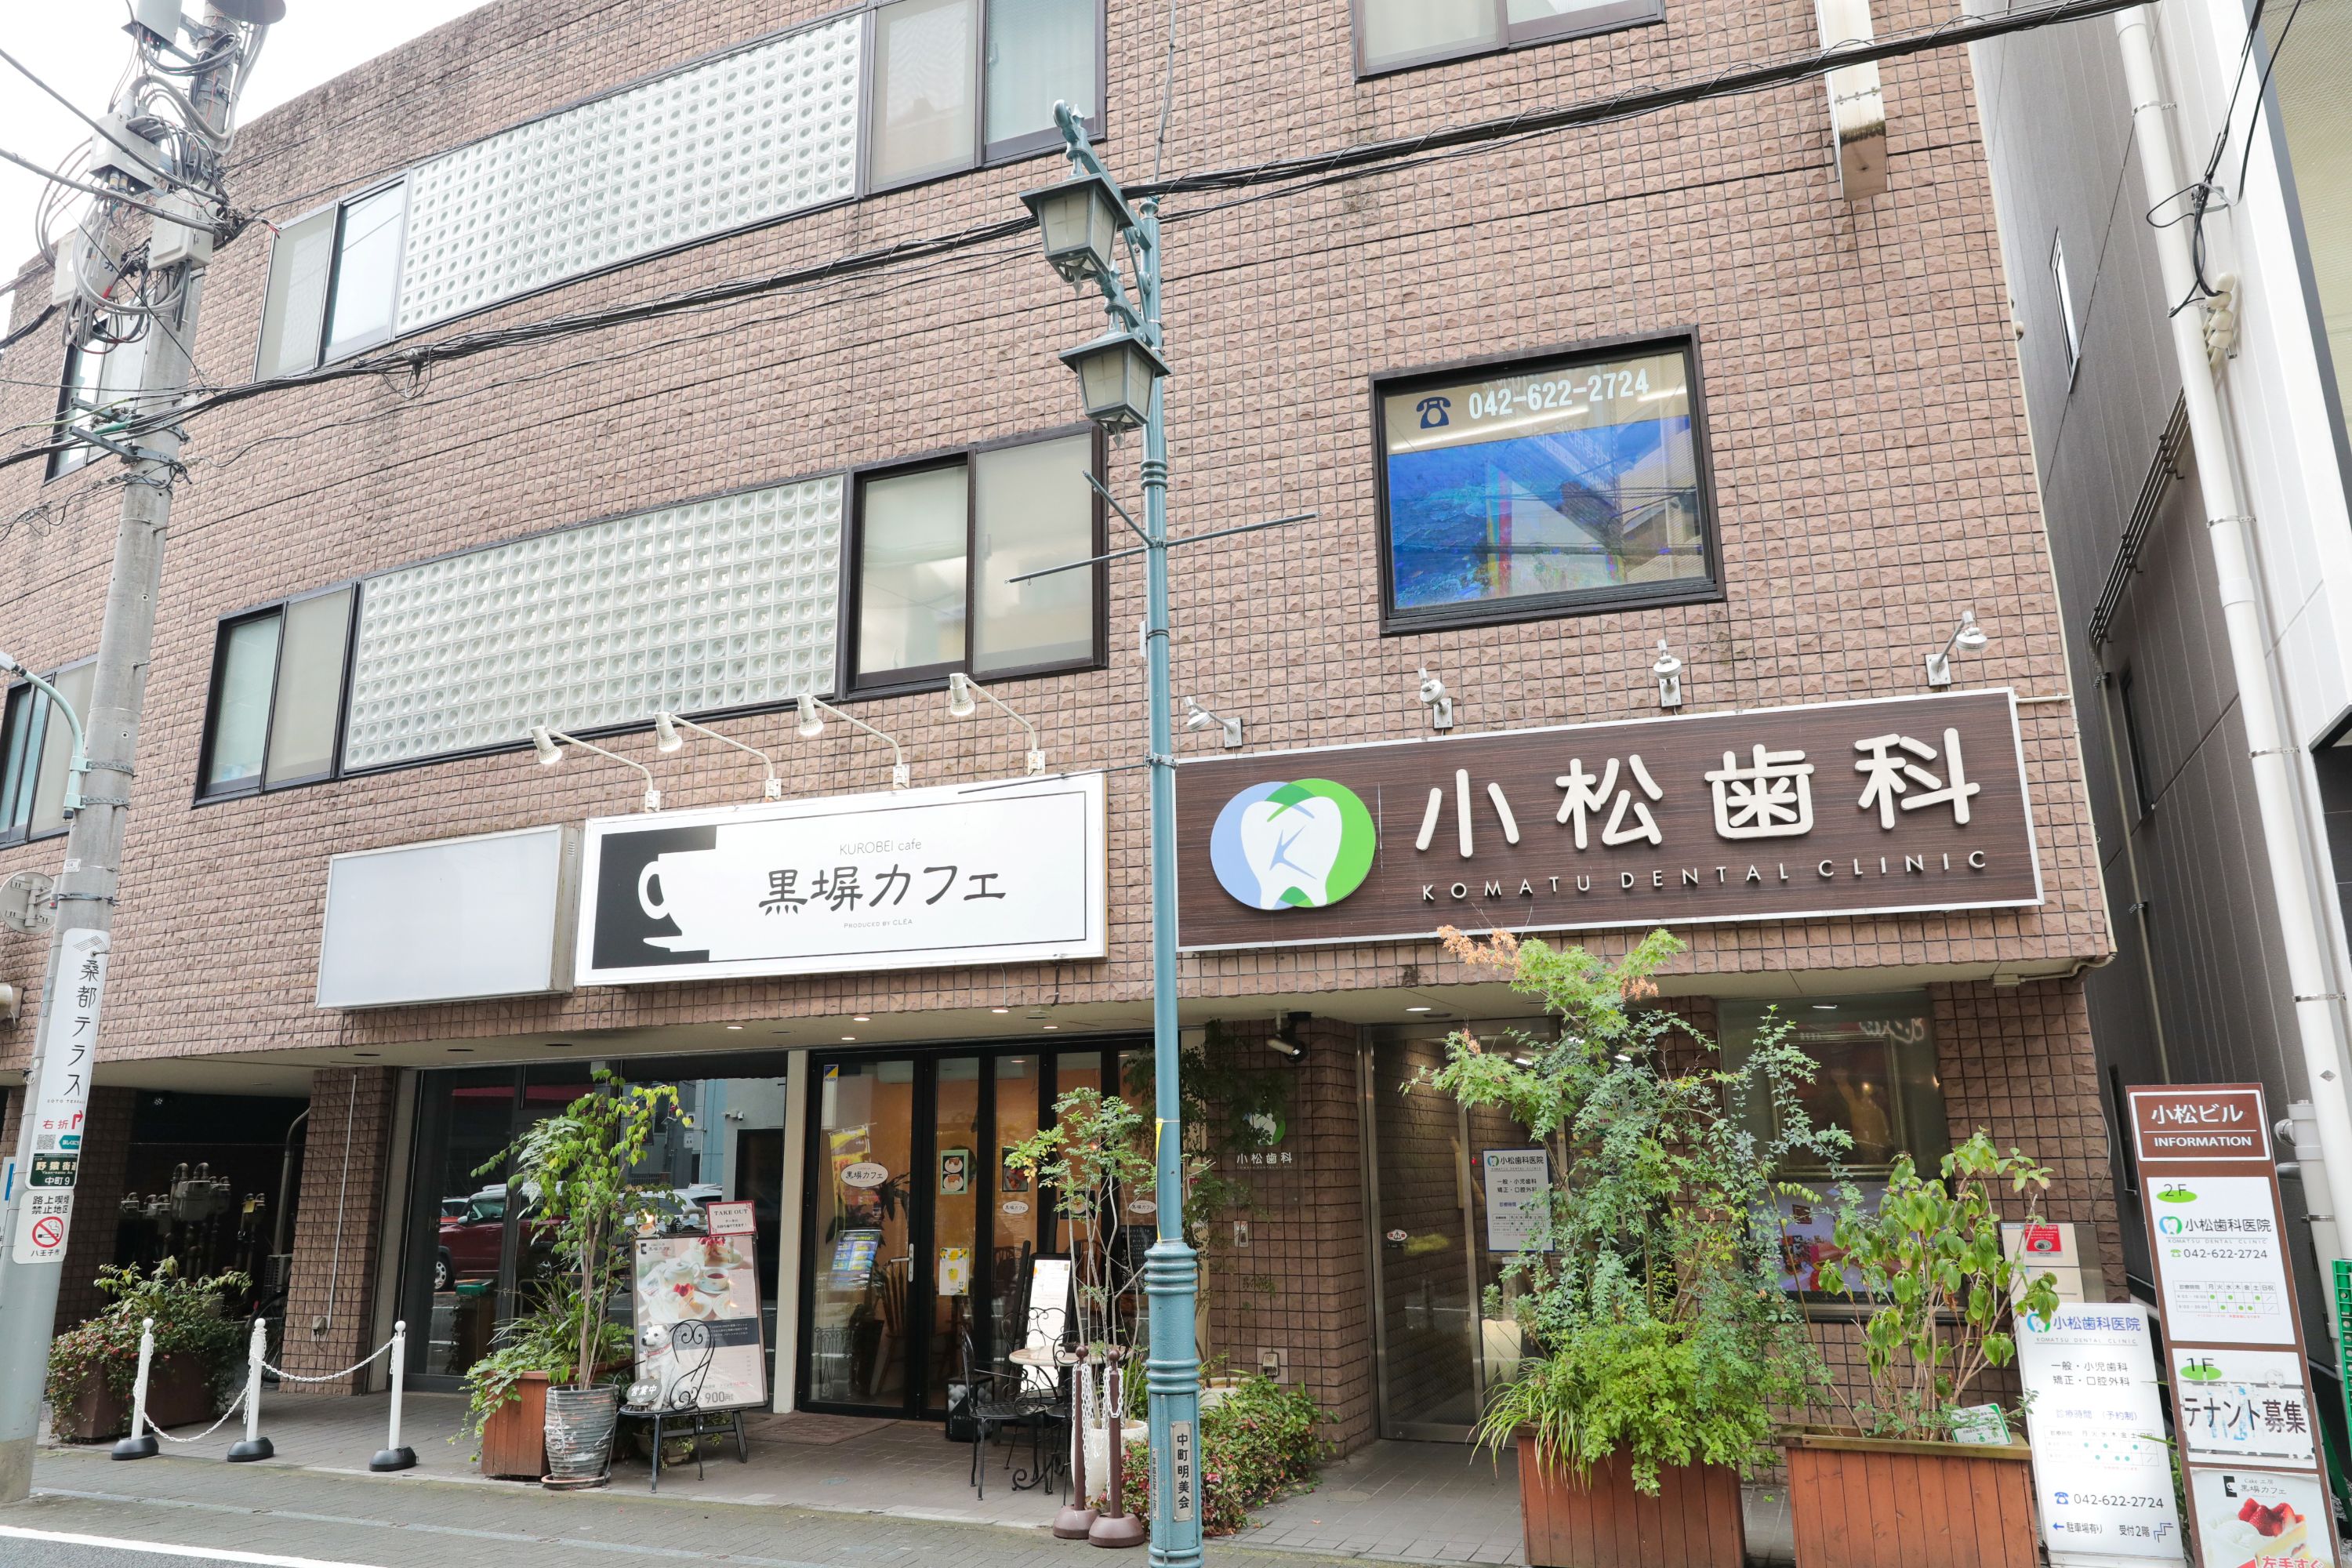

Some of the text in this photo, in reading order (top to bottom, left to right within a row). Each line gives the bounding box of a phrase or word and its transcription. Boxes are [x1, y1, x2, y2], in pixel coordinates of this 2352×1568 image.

[1468, 368, 1650, 419] 042-622-2724
[1415, 726, 1981, 859] 小松歯科
[840, 838, 922, 855] KUROBEI cafe
[1422, 851, 1987, 901] KOMATU DENTAL CLINIC
[758, 863, 1007, 916] 黒塀カフェ
[64, 960, 100, 1096] 桑都テラス
[2151, 1103, 2244, 1124] 小松ビル
[43, 1120, 68, 1130] 右折
[2154, 1136, 2252, 1146] INFORMATION
[1236, 1152, 1292, 1164] 小松歯科
[1500, 1156, 1544, 1164] 小松歯科医院
[45, 1177, 71, 1185] 中町 9
[846, 1171, 884, 1180] 黒塀カフェ
[2164, 1184, 2187, 1196] 2F
[32, 1196, 70, 1205] 路上喫煙
[31, 1205, 68, 1214] 禁止地区
[2185, 1218, 2272, 1232] 小松歯科医院
[2183, 1249, 2268, 1258] 042-622-2724
[2053, 1316, 2142, 1331] 小松歯科医院
[2051, 1361, 2129, 1372] 一般・小児歯科
[2053, 1375, 2130, 1386] 矯正・口腔外科
[631, 1384, 657, 1396] 営業中
[2184, 1397, 2307, 1434] テナント募集
[1177, 1433, 1190, 1509] 中町明美会
[2074, 1494, 2164, 1508] 042-622-2724
[2066, 1522, 2151, 1537] 駐車場有り 受付2階
